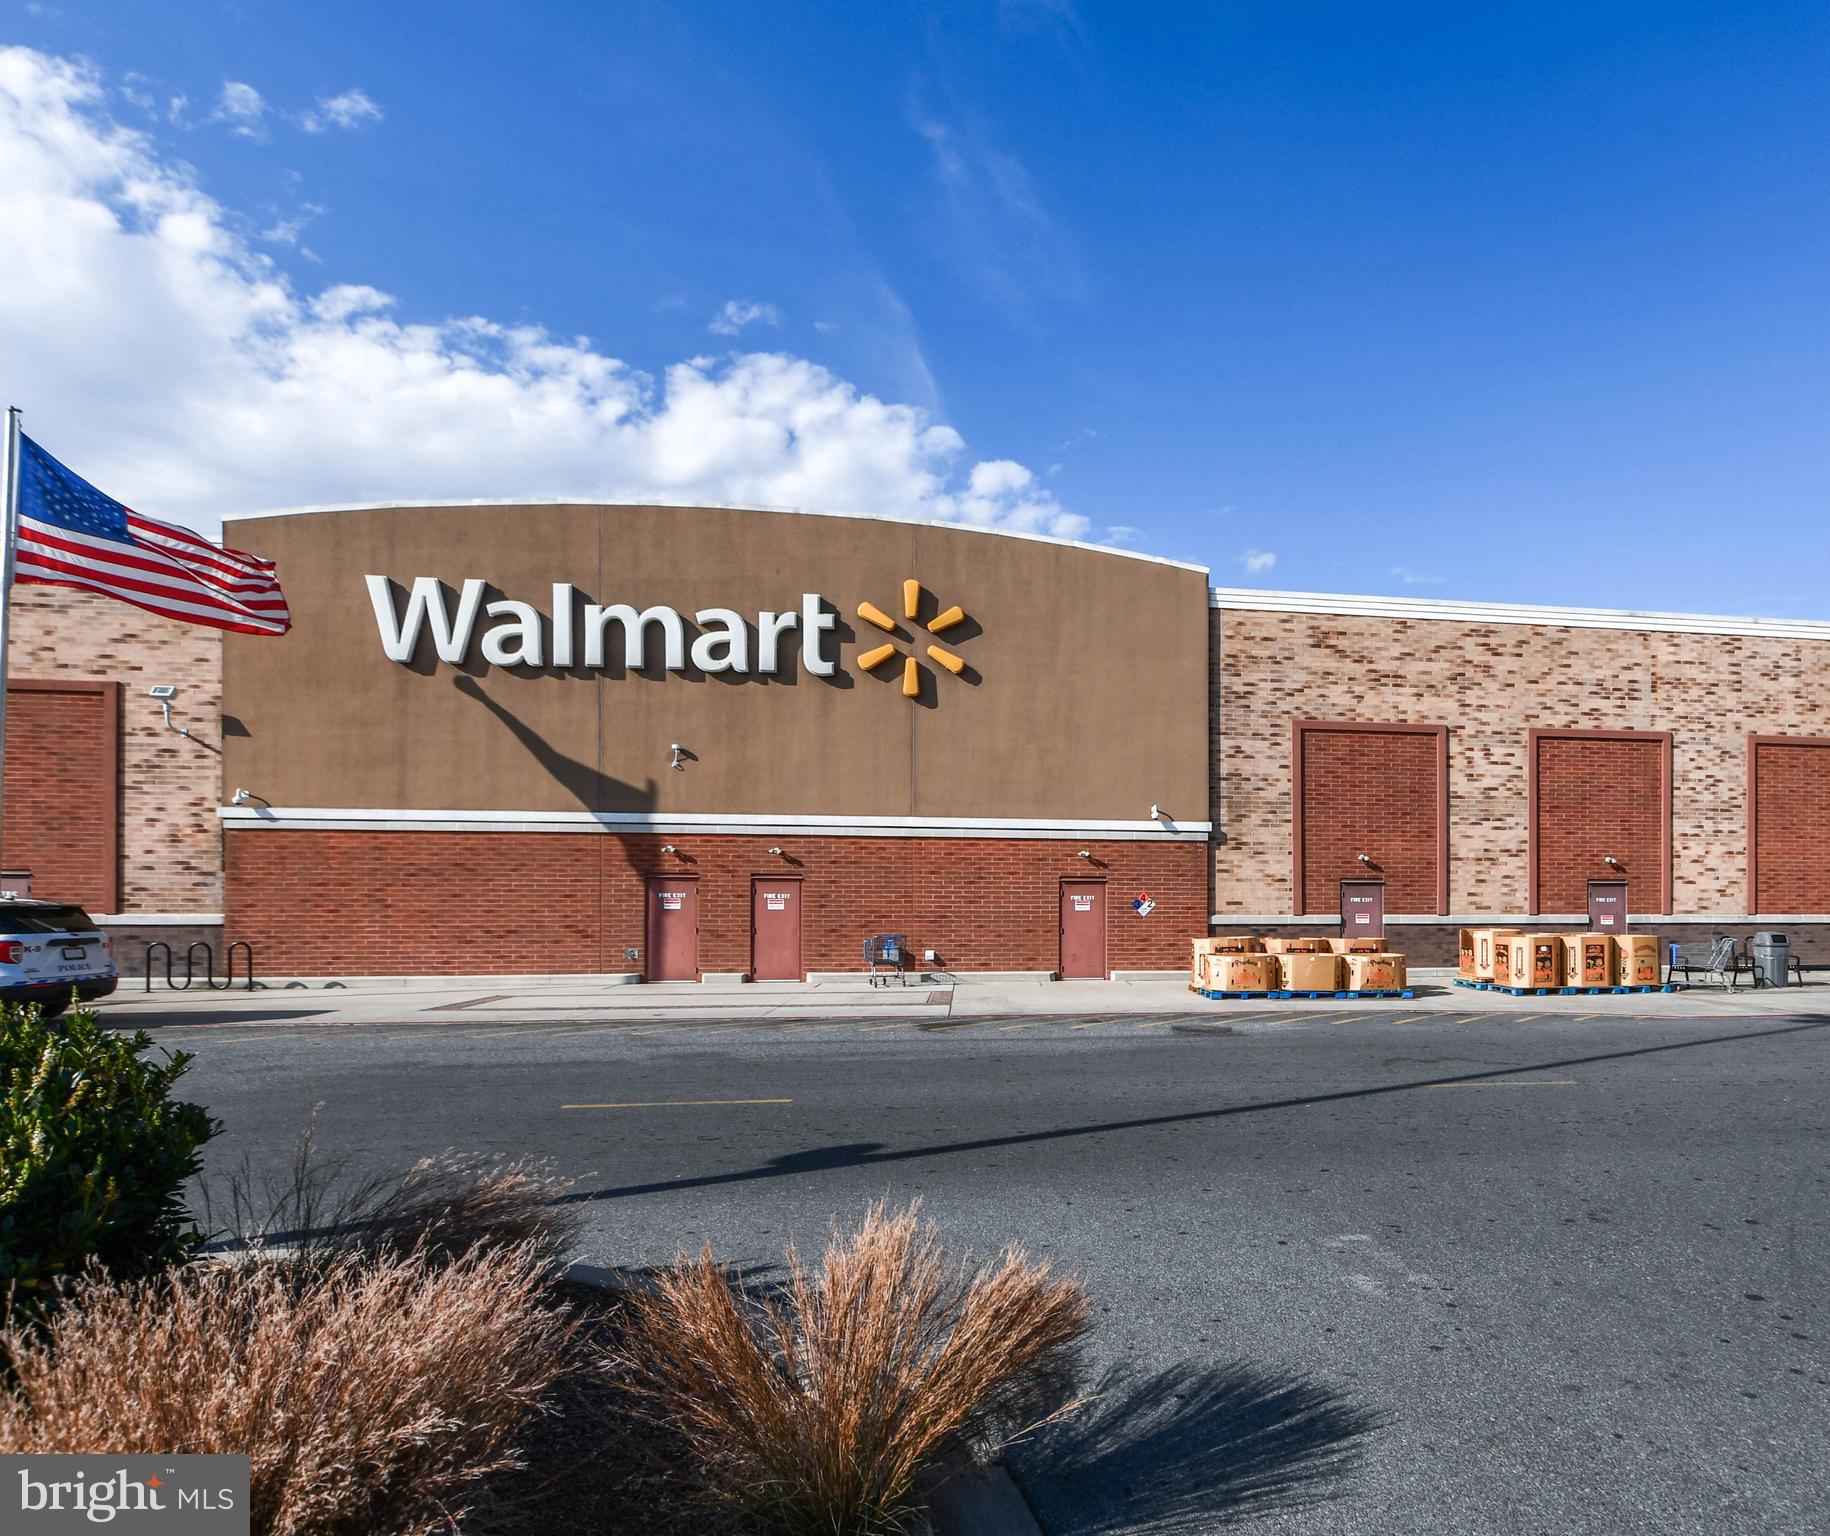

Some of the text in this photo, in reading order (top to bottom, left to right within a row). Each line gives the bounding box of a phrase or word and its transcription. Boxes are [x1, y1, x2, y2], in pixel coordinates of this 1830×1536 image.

[365, 574, 836, 677] Walmart
[1147, 899, 1153, 908] 2
[23, 945, 41, 953] K-9
[58, 963, 91, 972] POLICE
